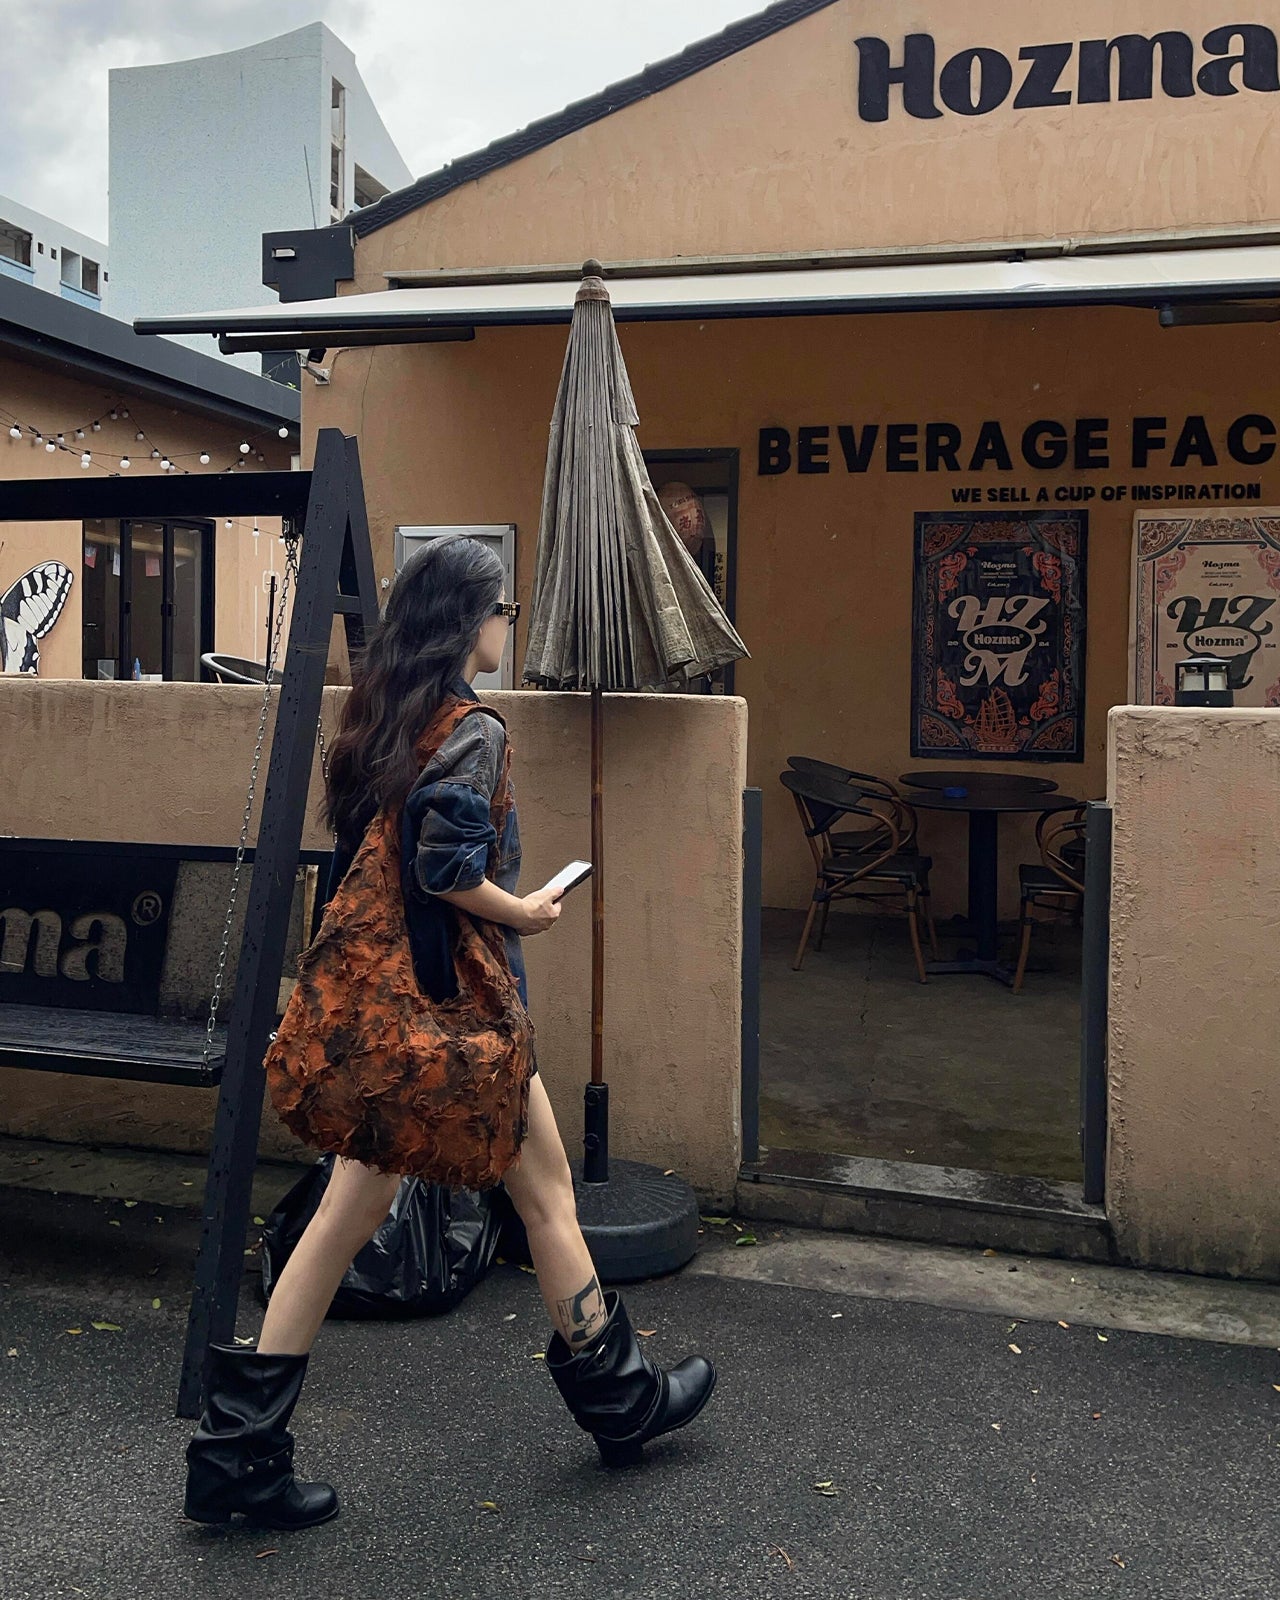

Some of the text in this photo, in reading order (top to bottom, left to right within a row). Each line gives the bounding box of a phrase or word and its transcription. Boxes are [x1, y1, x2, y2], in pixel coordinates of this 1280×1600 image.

[853, 24, 1280, 122] Hozma
[757, 414, 1277, 476] BEVERAGE FAC
[951, 483, 1261, 503] WE SELL A CUP OF INSPIRATION
[974, 633, 1021, 646] Hozma
[1195, 635, 1245, 648] Hozma
